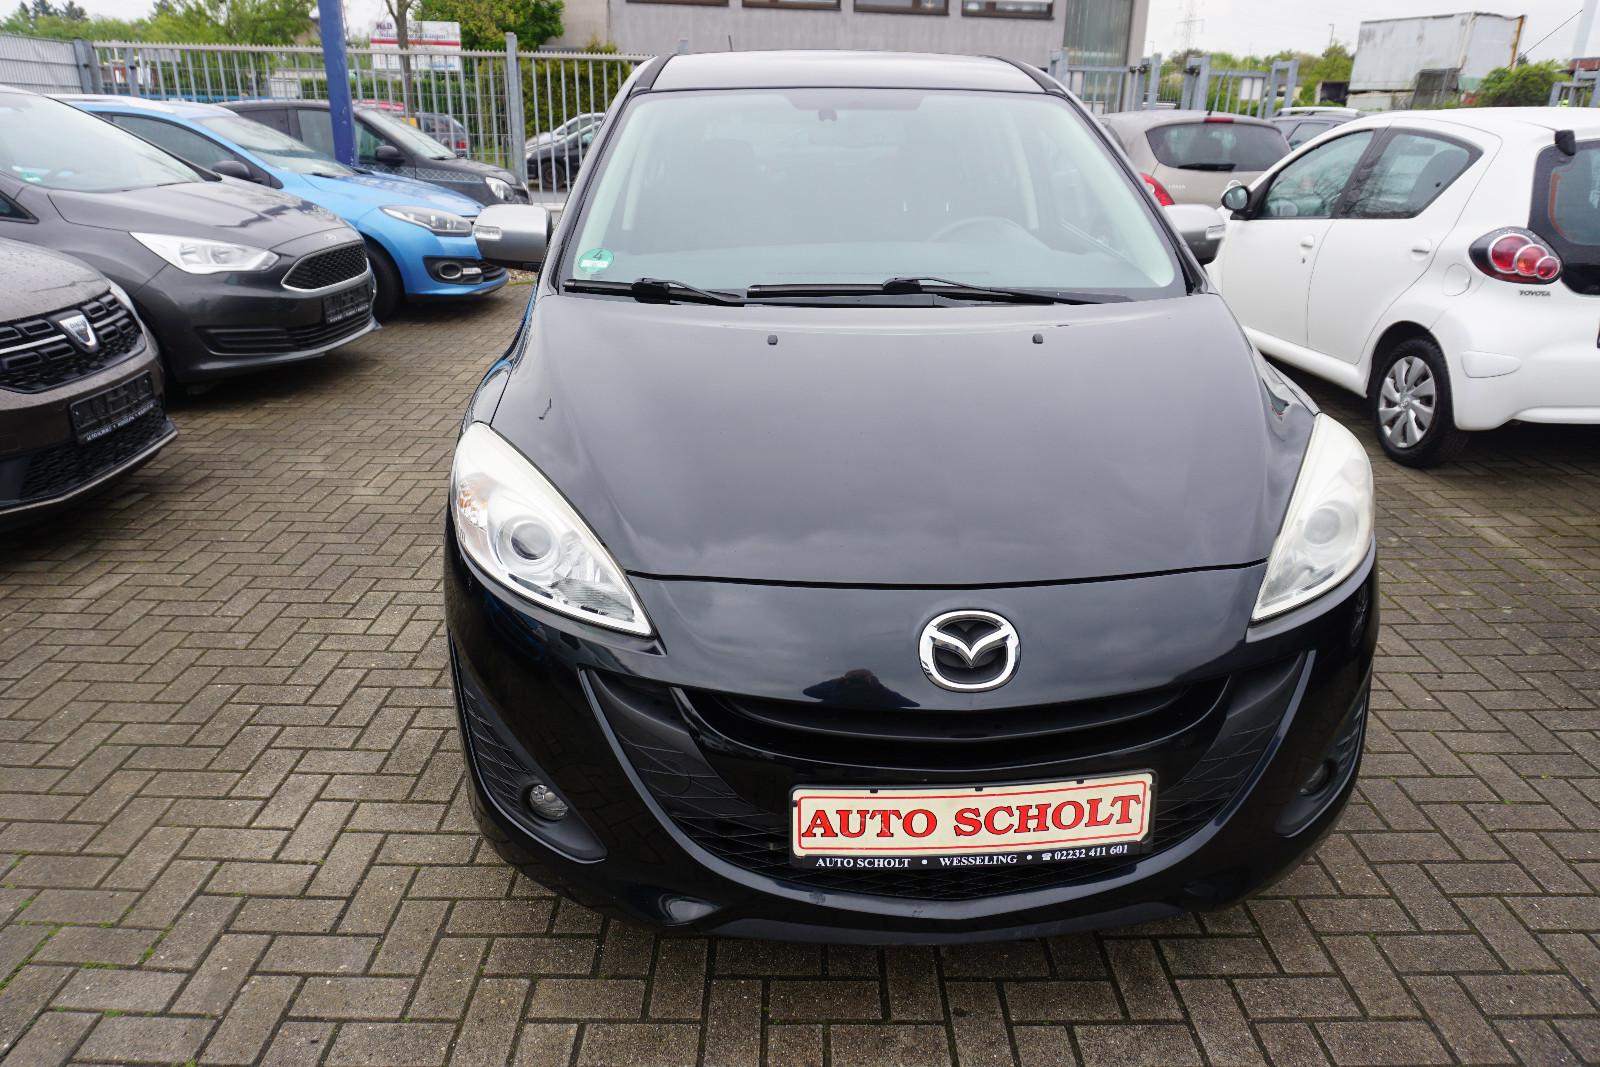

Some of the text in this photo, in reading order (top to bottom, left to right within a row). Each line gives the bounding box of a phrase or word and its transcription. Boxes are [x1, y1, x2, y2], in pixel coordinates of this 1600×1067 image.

[592, 249, 604, 261] 4
[801, 794, 1142, 838] AUTO SCHOLT
[815, 844, 1128, 868] AUTO SCHOLT WESSELING 02232 411 601
